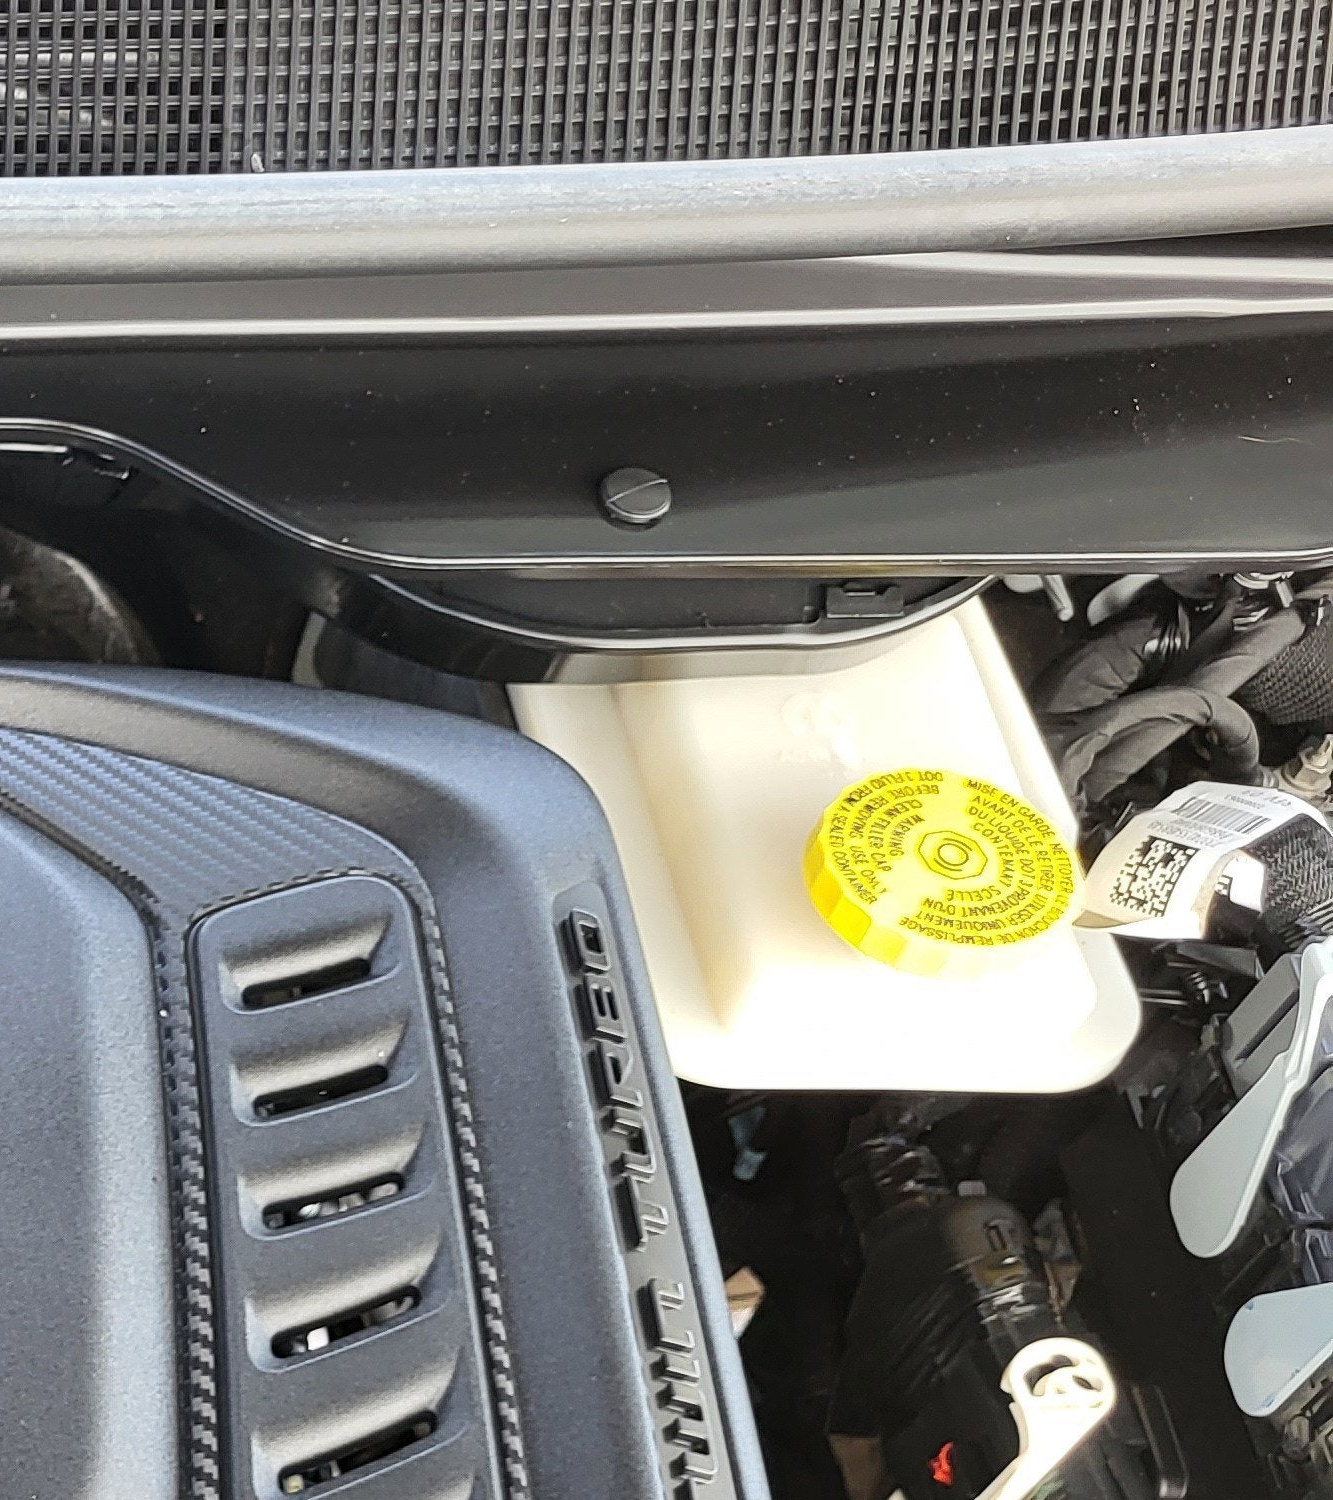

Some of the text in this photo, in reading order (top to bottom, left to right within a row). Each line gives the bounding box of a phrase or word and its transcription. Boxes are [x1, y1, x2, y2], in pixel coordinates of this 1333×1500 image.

[968, 805, 989, 819] DU
[973, 795, 1015, 820] AVANT
[999, 793, 1019, 807] EN
[1018, 806, 1055, 838] GARDE
[889, 814, 925, 857] WARNING
[559, 908, 669, 1252] TURBO
